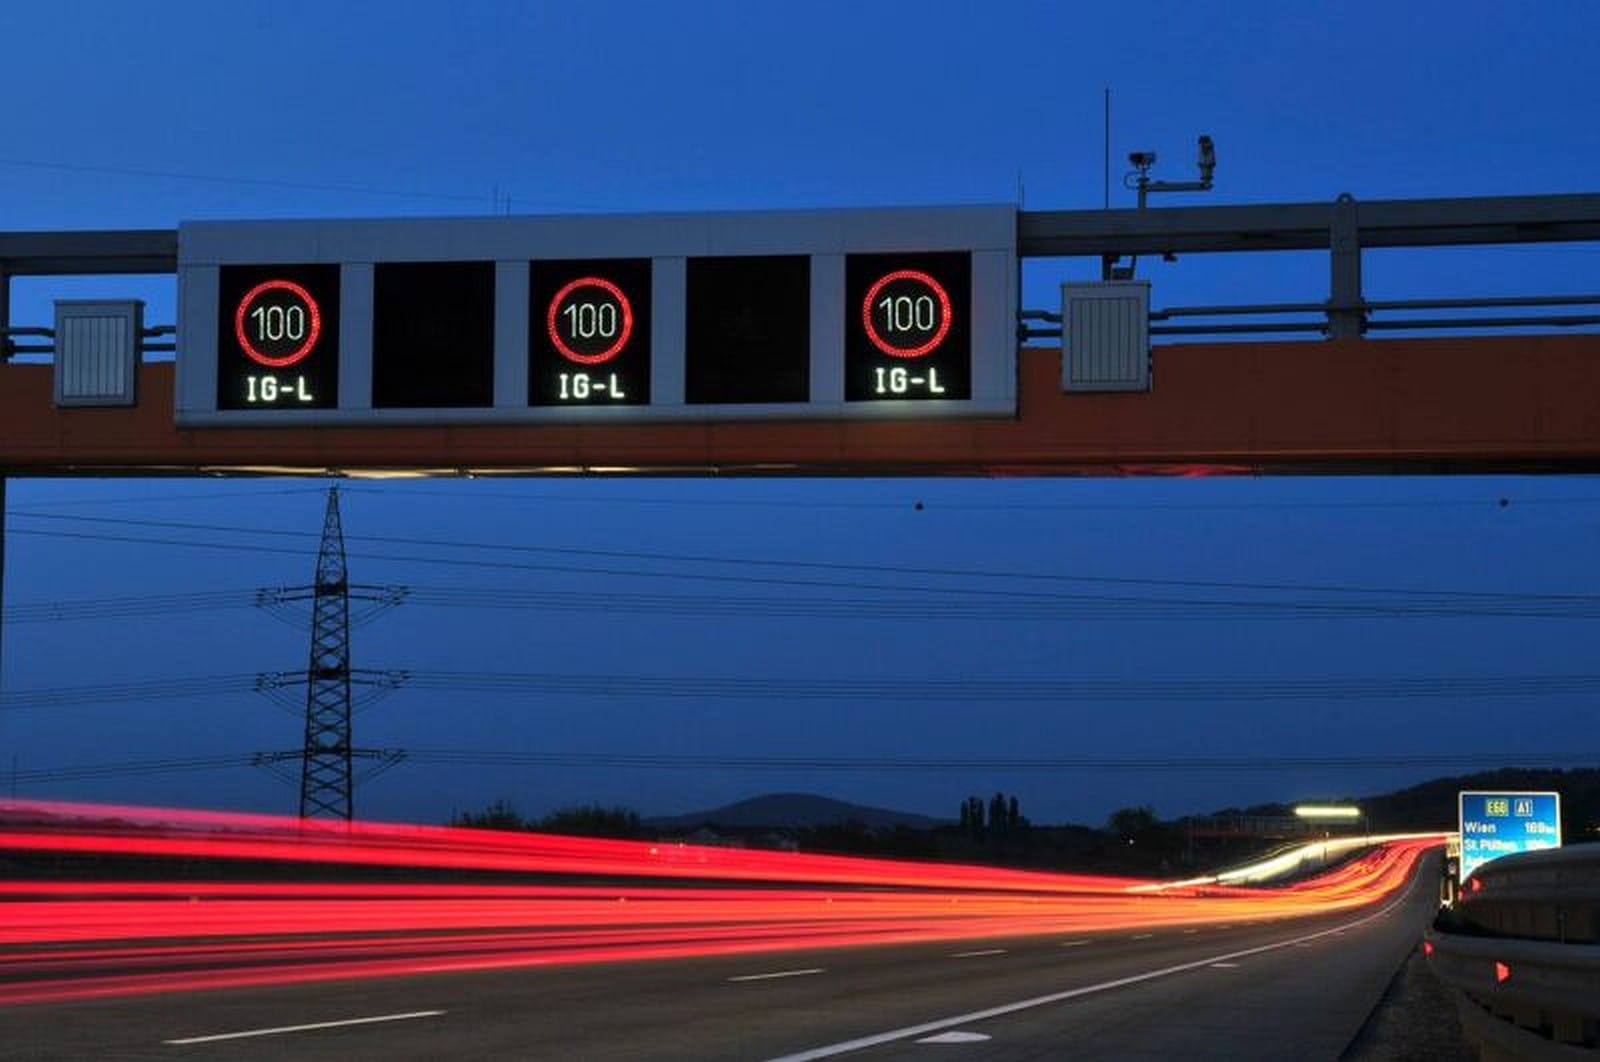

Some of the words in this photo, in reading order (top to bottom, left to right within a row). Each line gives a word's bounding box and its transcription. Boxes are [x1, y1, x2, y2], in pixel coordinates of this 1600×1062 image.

[251, 305, 304, 341] 100
[563, 303, 616, 339] 100
[879, 295, 934, 332] 100
[247, 376, 313, 402] IG-L
[559, 373, 625, 399] IG-L
[875, 367, 945, 393] IG-L
[1516, 801, 1530, 814] A1
[1464, 821, 1497, 833] Wien
